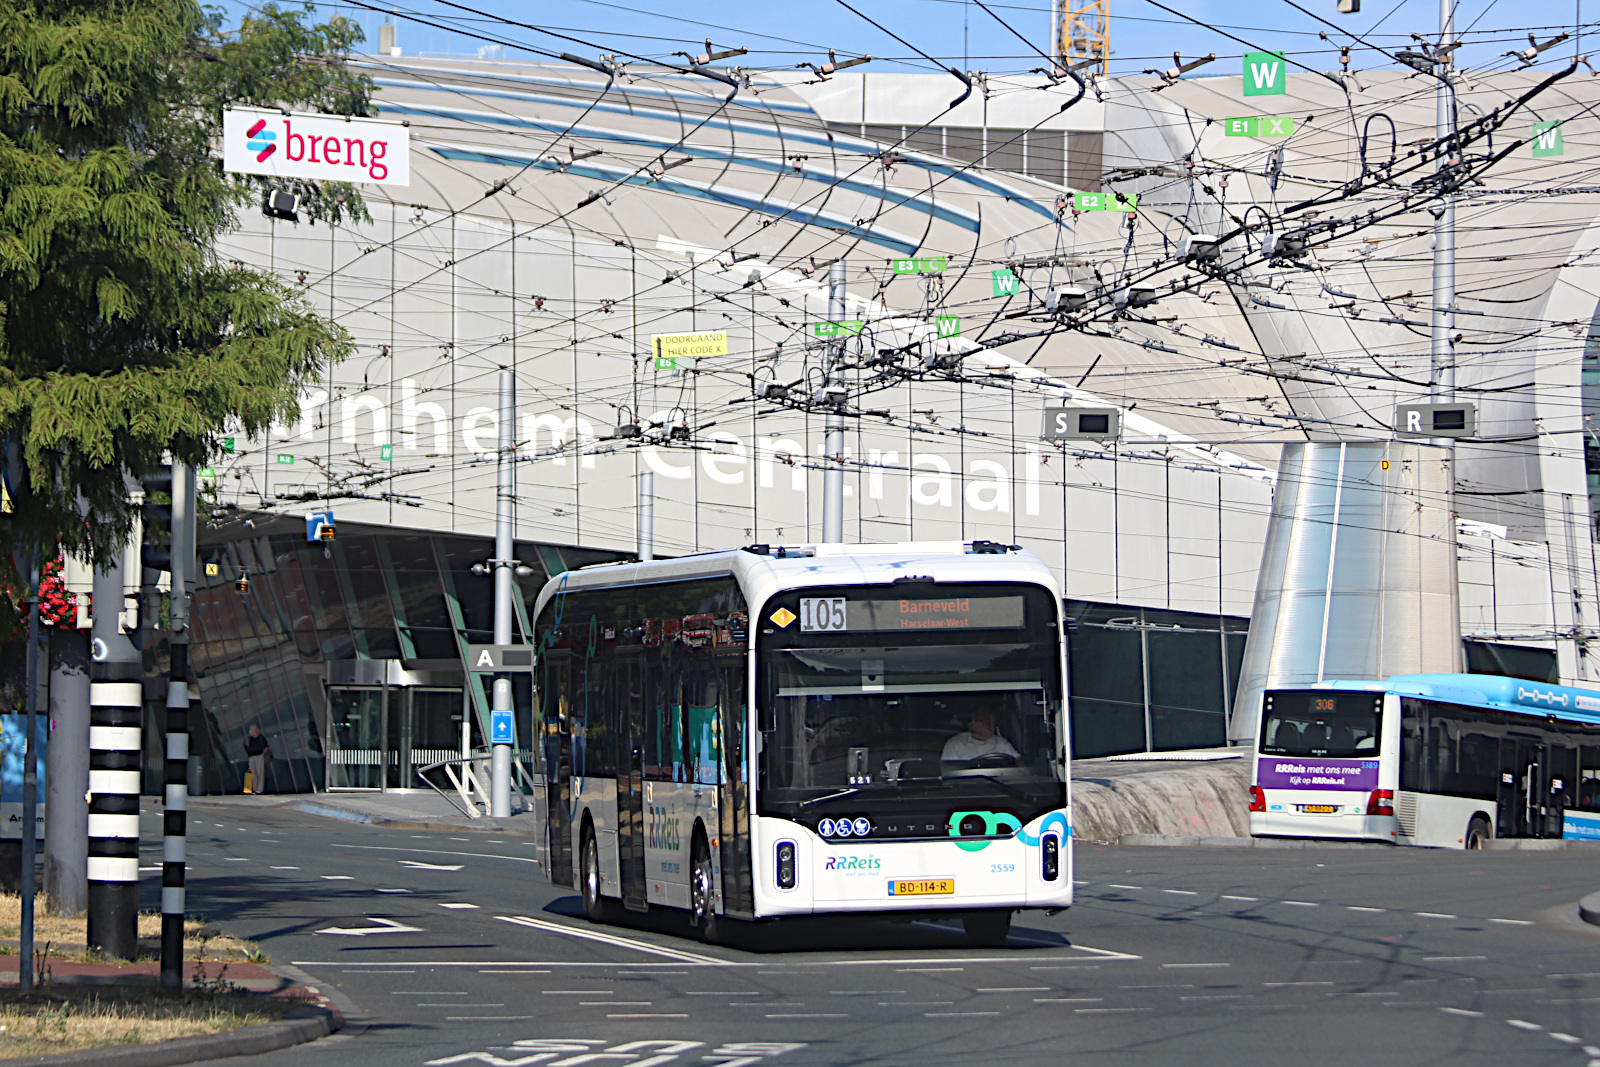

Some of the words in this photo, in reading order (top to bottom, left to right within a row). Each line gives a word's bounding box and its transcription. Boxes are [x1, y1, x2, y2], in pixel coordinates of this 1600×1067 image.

[1250, 62, 1279, 89] W
[1232, 120, 1248, 132] E1
[1269, 119, 1284, 134] X
[1536, 127, 1557, 150] W
[283, 119, 388, 180] breng
[1081, 196, 1098, 207] E2
[898, 260, 914, 271] E3
[928, 259, 939, 270] C
[996, 275, 1014, 292] W
[819, 324, 834, 333] E4
[938, 319, 957, 335] W
[665, 334, 723, 344] DOORGAAND
[667, 347, 689, 355] HIER
[690, 346, 713, 354] CODE
[222, 378, 595, 469] rnhem
[1055, 412, 1068, 434] S
[1407, 410, 1422, 432] R
[382, 447, 392, 458] W
[1381, 460, 1389, 470] D
[208, 564, 215, 574] X
[803, 599, 845, 630] 105
[900, 598, 970, 613] Barneveld
[900, 618, 969, 628] Harselaar-West
[476, 649, 494, 667] A
[1315, 699, 1334, 710] 306
[1275, 764, 1306, 774] RRReis
[1307, 765, 1324, 774] met
[1342, 767, 1361, 775] mee
[1361, 761, 1378, 769] 5389
[1290, 776, 1302, 785] Kijk
[1312, 777, 1345, 785] RRReis.nl
[649, 802, 680, 851] RRReis
[870, 823, 973, 832] YUTONG
[825, 854, 881, 870] RRReis
[990, 863, 1015, 873] 2559
[900, 881, 947, 893] BD-114-R
